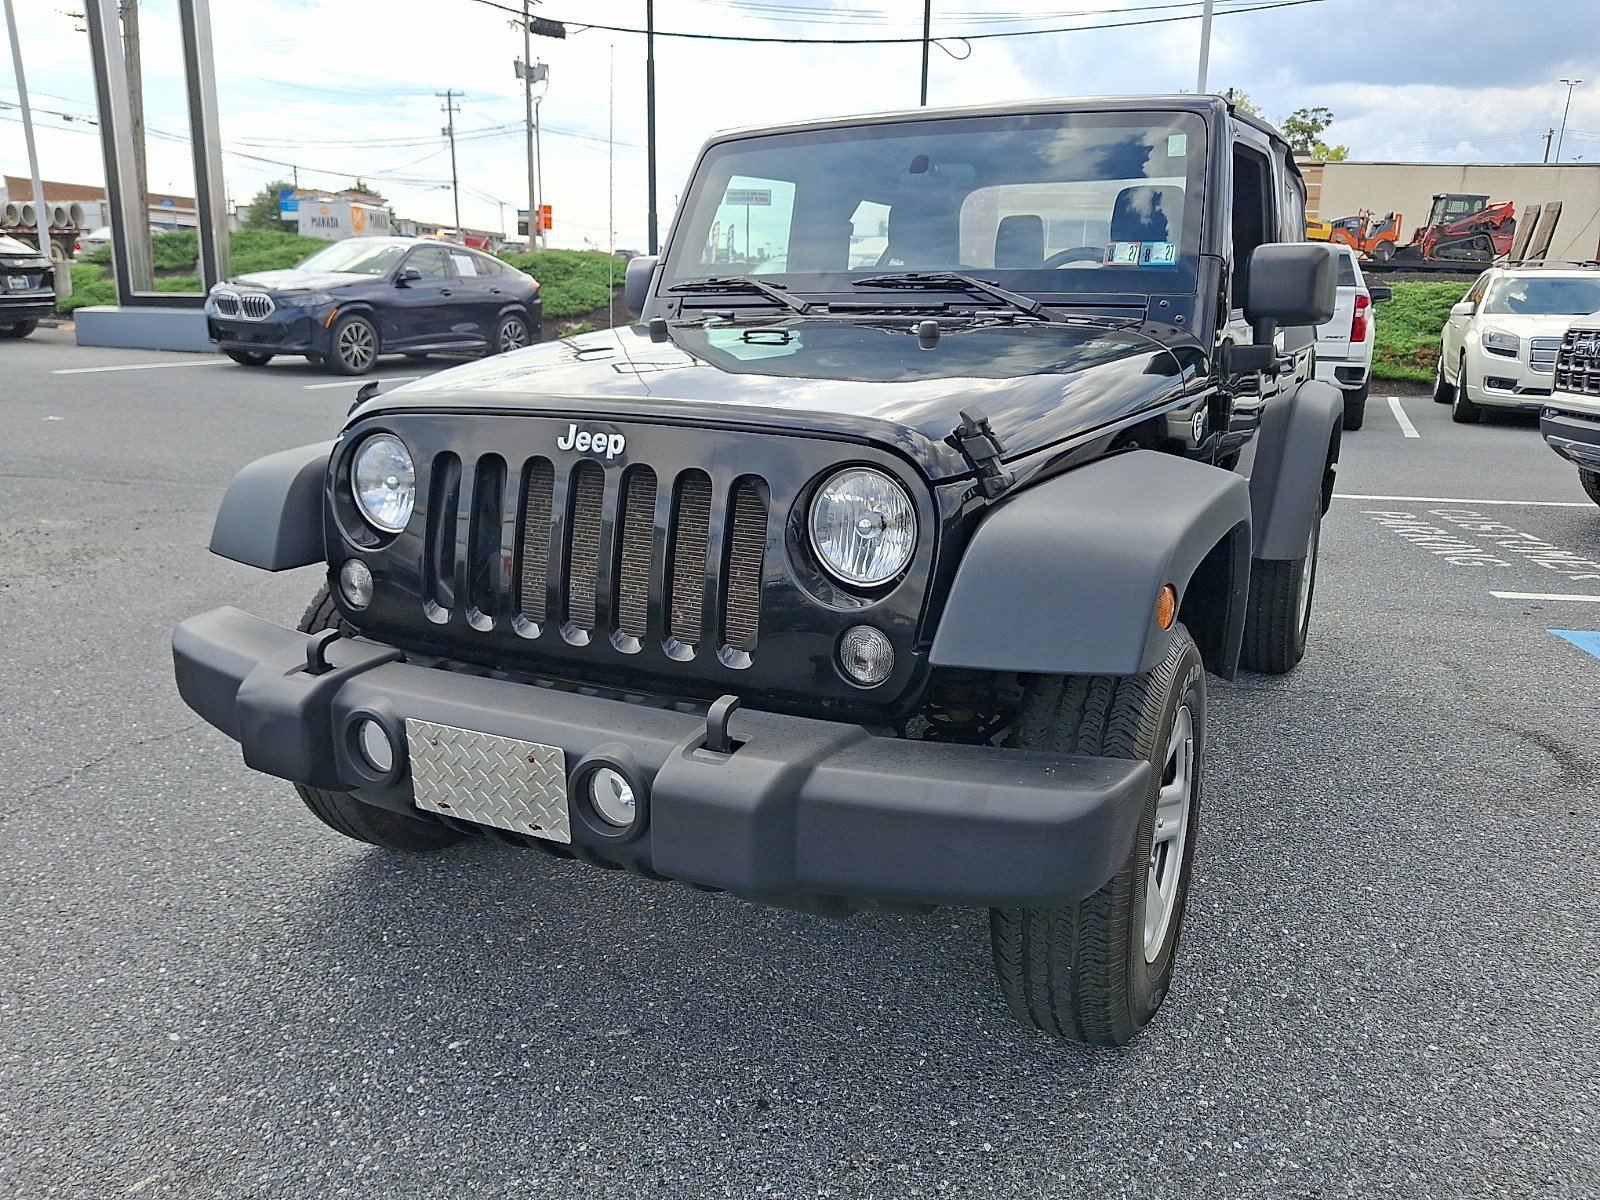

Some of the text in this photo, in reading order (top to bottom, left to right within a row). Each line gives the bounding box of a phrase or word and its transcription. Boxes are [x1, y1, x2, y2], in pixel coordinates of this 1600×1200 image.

[1108, 245, 1138, 262] 8 27
[1144, 245, 1174, 262] 8 27
[1575, 340, 1600, 357] GM
[557, 423, 626, 460] Jeep
[1359, 511, 1512, 567] PARKING
